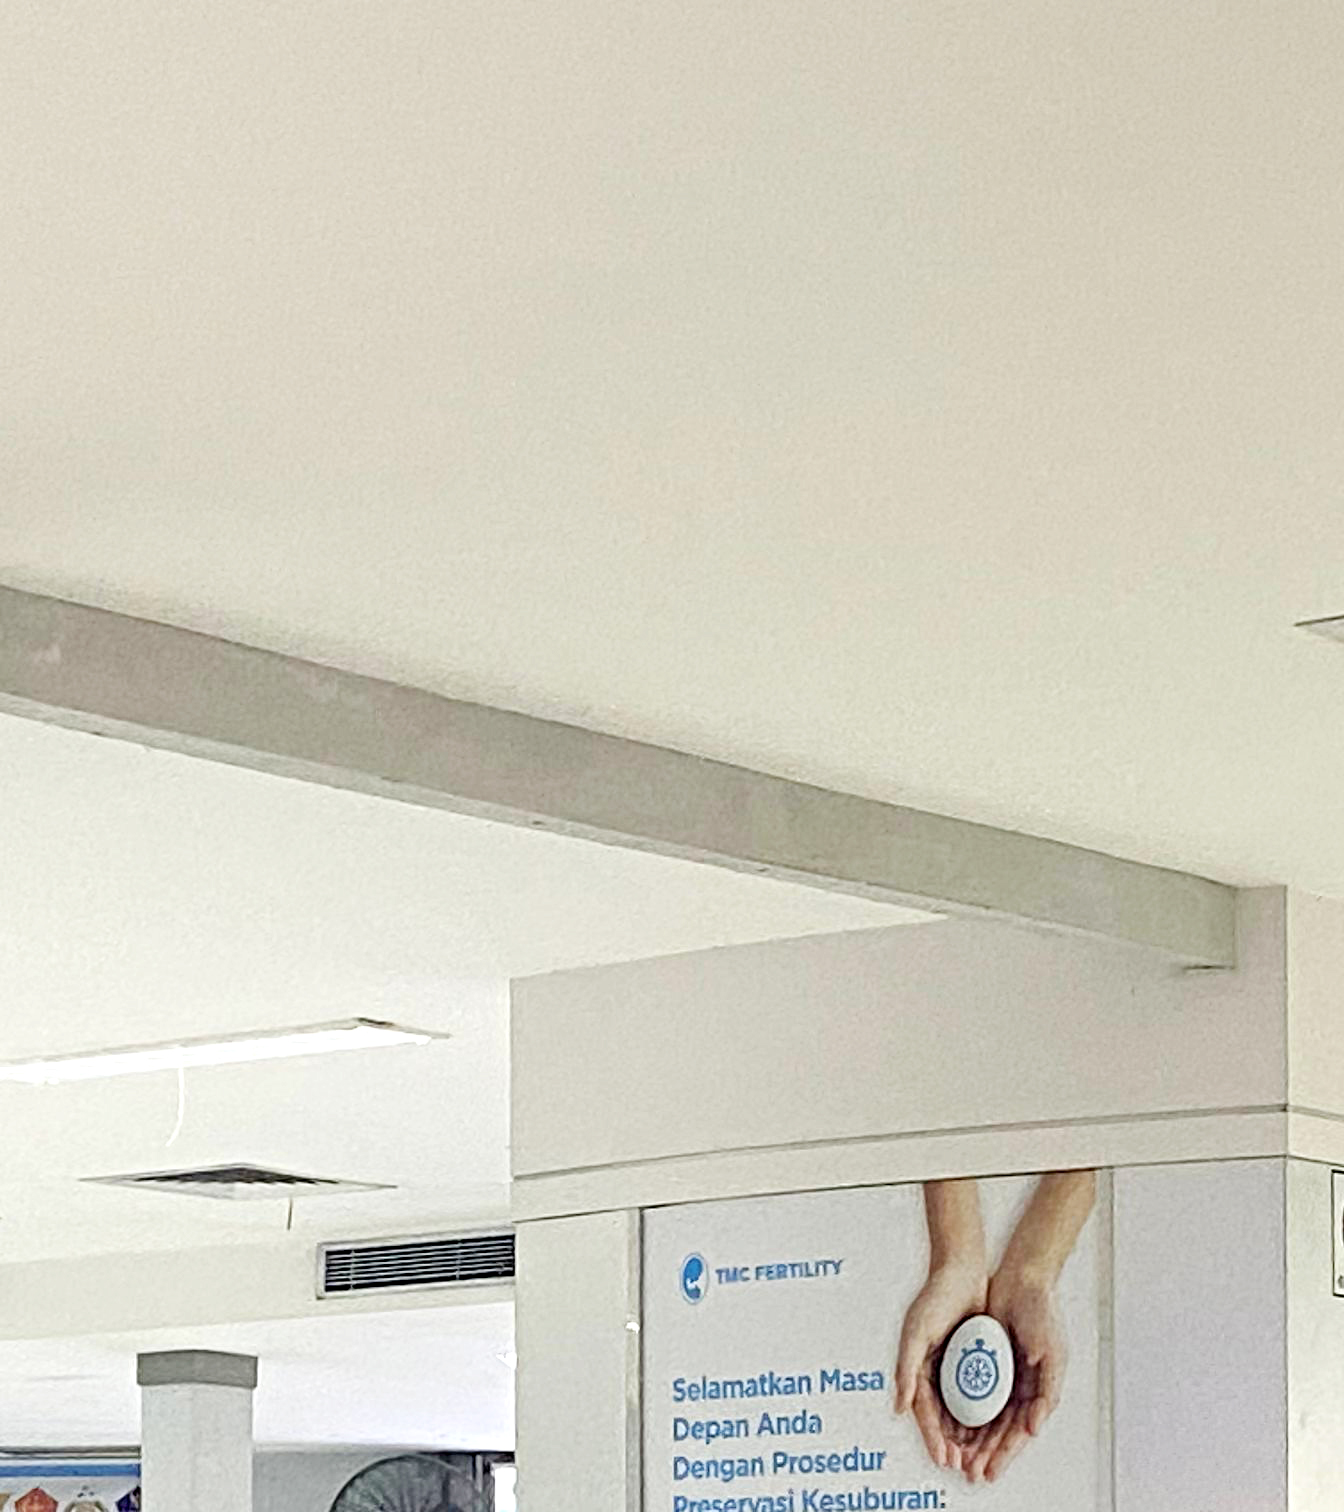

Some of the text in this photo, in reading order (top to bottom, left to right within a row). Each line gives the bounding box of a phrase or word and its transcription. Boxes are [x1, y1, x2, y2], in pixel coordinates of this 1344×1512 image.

[716, 1259, 844, 1284] TMC FERTILITY
[673, 1369, 885, 1402] Selamatkan Masa
[673, 1410, 822, 1445] Depan Anda
[673, 1446, 887, 1482] Dengan Prosedur
